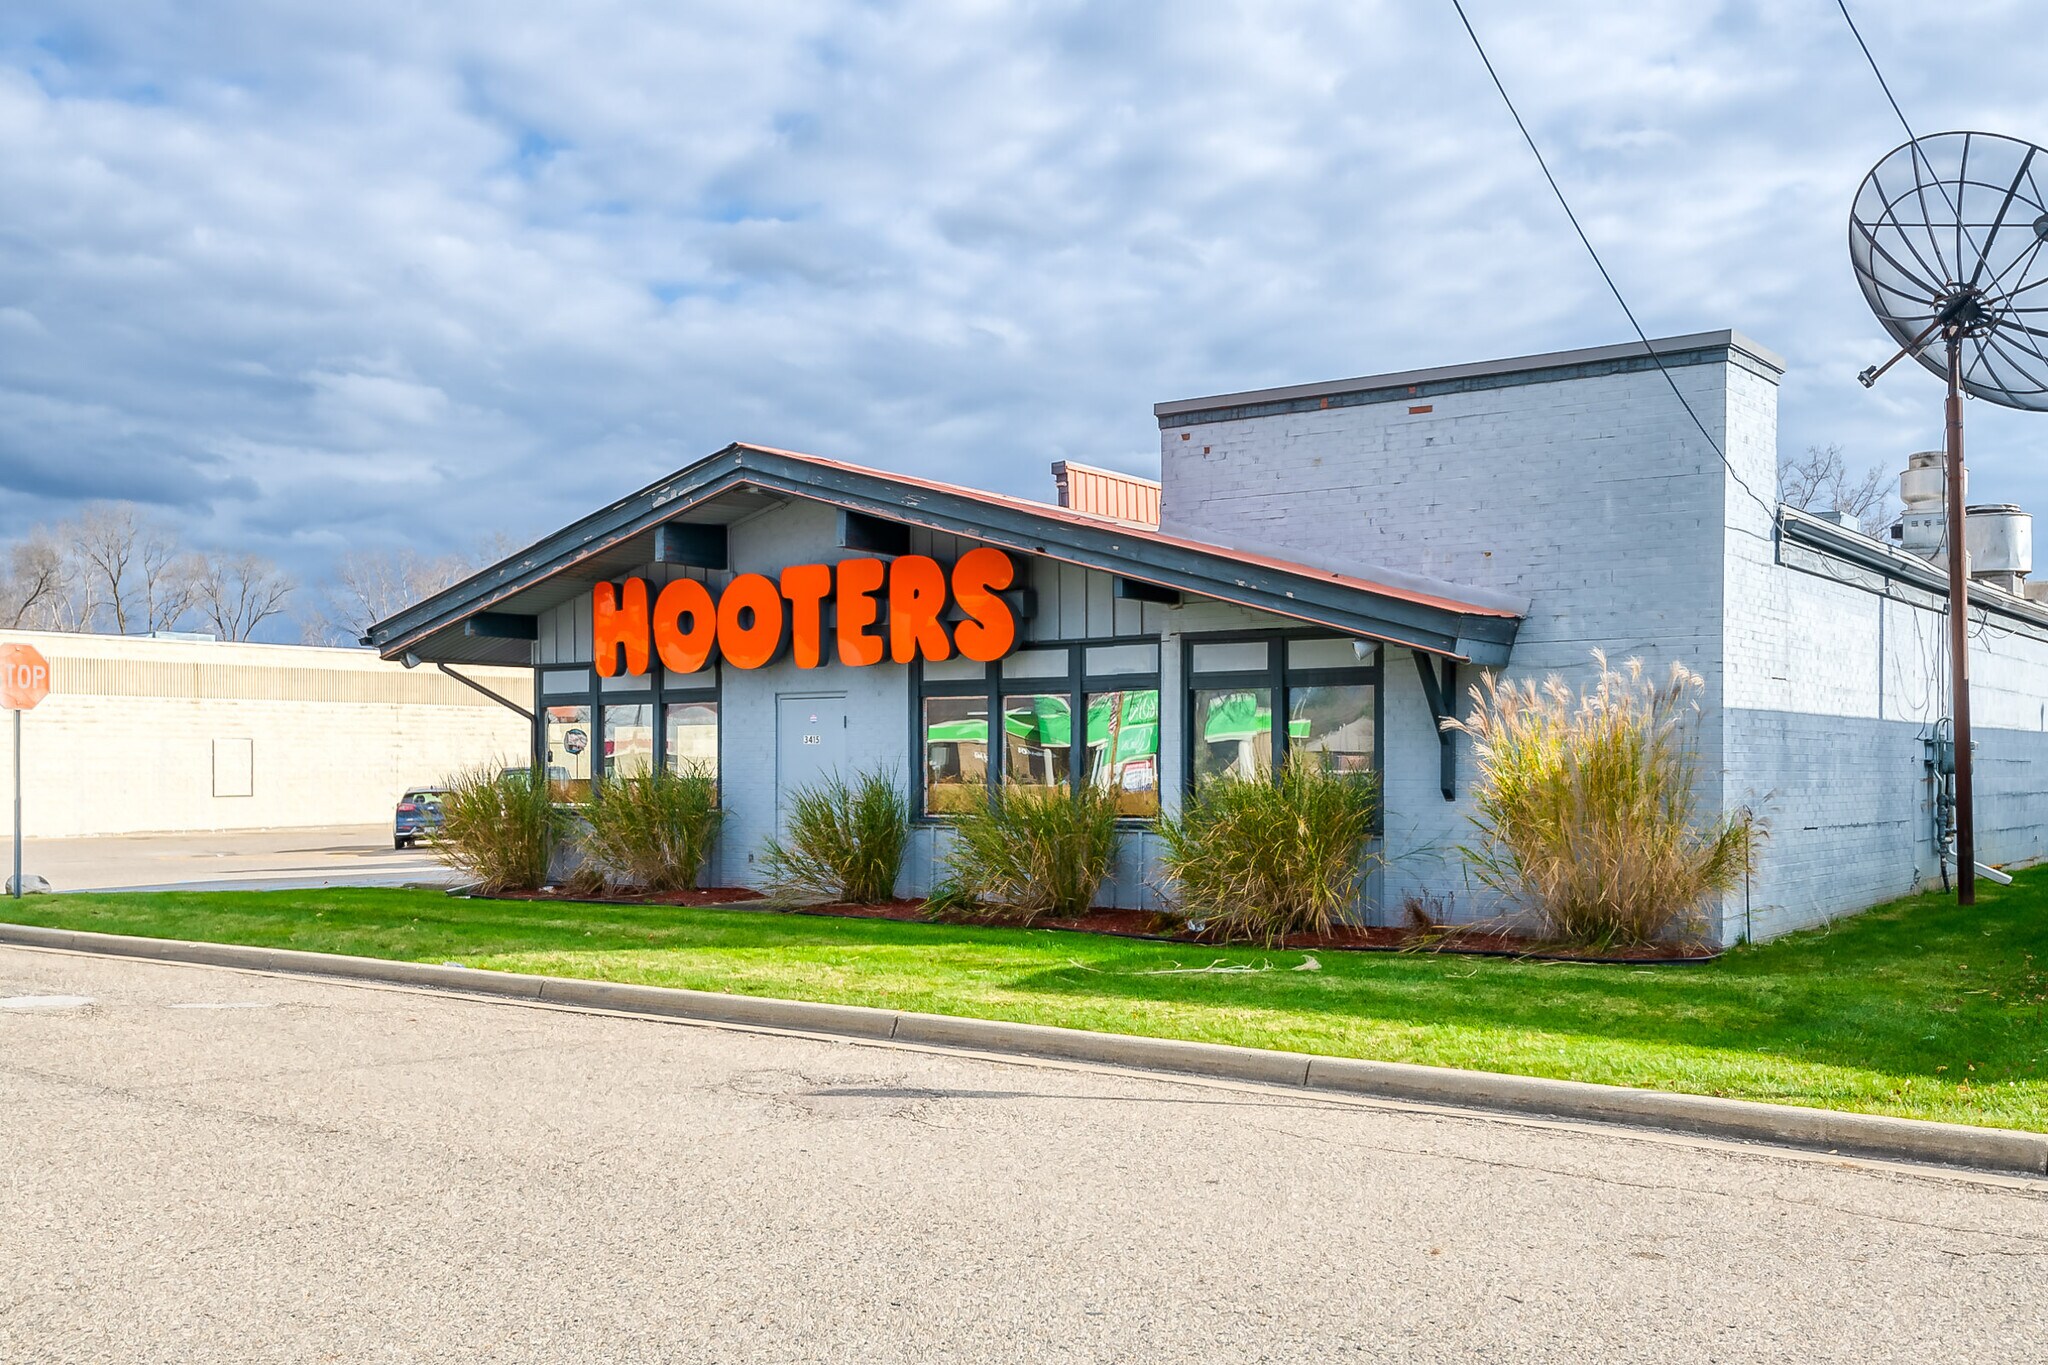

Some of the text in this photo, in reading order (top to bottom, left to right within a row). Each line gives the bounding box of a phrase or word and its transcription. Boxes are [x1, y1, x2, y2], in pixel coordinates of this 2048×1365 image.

[593, 547, 1017, 678] HOOTERS
[0, 663, 46, 689] TOP
[804, 735, 820, 744] 3415
